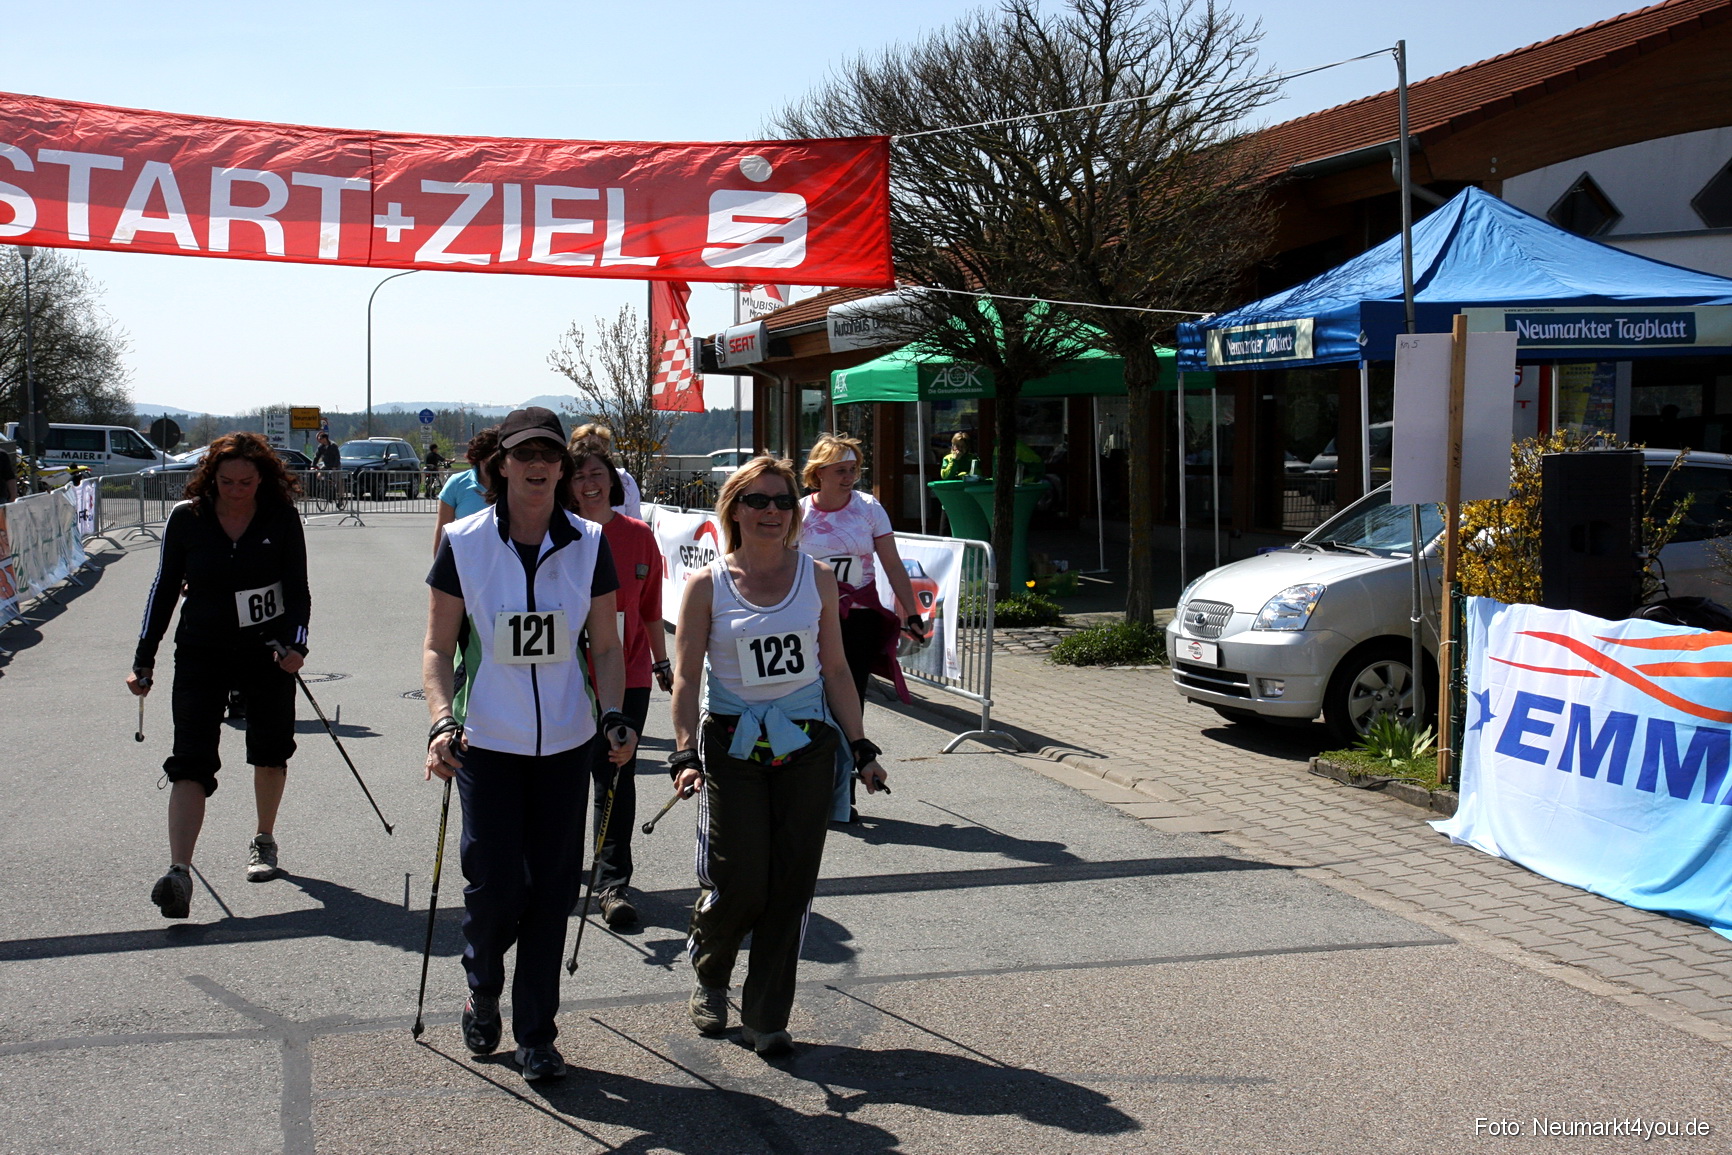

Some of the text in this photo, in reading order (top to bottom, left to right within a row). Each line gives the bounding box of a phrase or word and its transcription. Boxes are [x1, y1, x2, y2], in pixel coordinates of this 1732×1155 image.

[1515, 318, 1687, 341] Neumarkter Tagblatt
[728, 334, 755, 354] SEAT
[834, 373, 848, 393] AOK
[930, 366, 983, 388] AOK
[61, 451, 96, 460] MAIER
[679, 545, 716, 569] GERHAR
[830, 557, 852, 582] 77
[248, 589, 277, 623] 68
[508, 614, 556, 657] 121
[749, 633, 805, 678] 123
[1494, 690, 1732, 807] EMM
